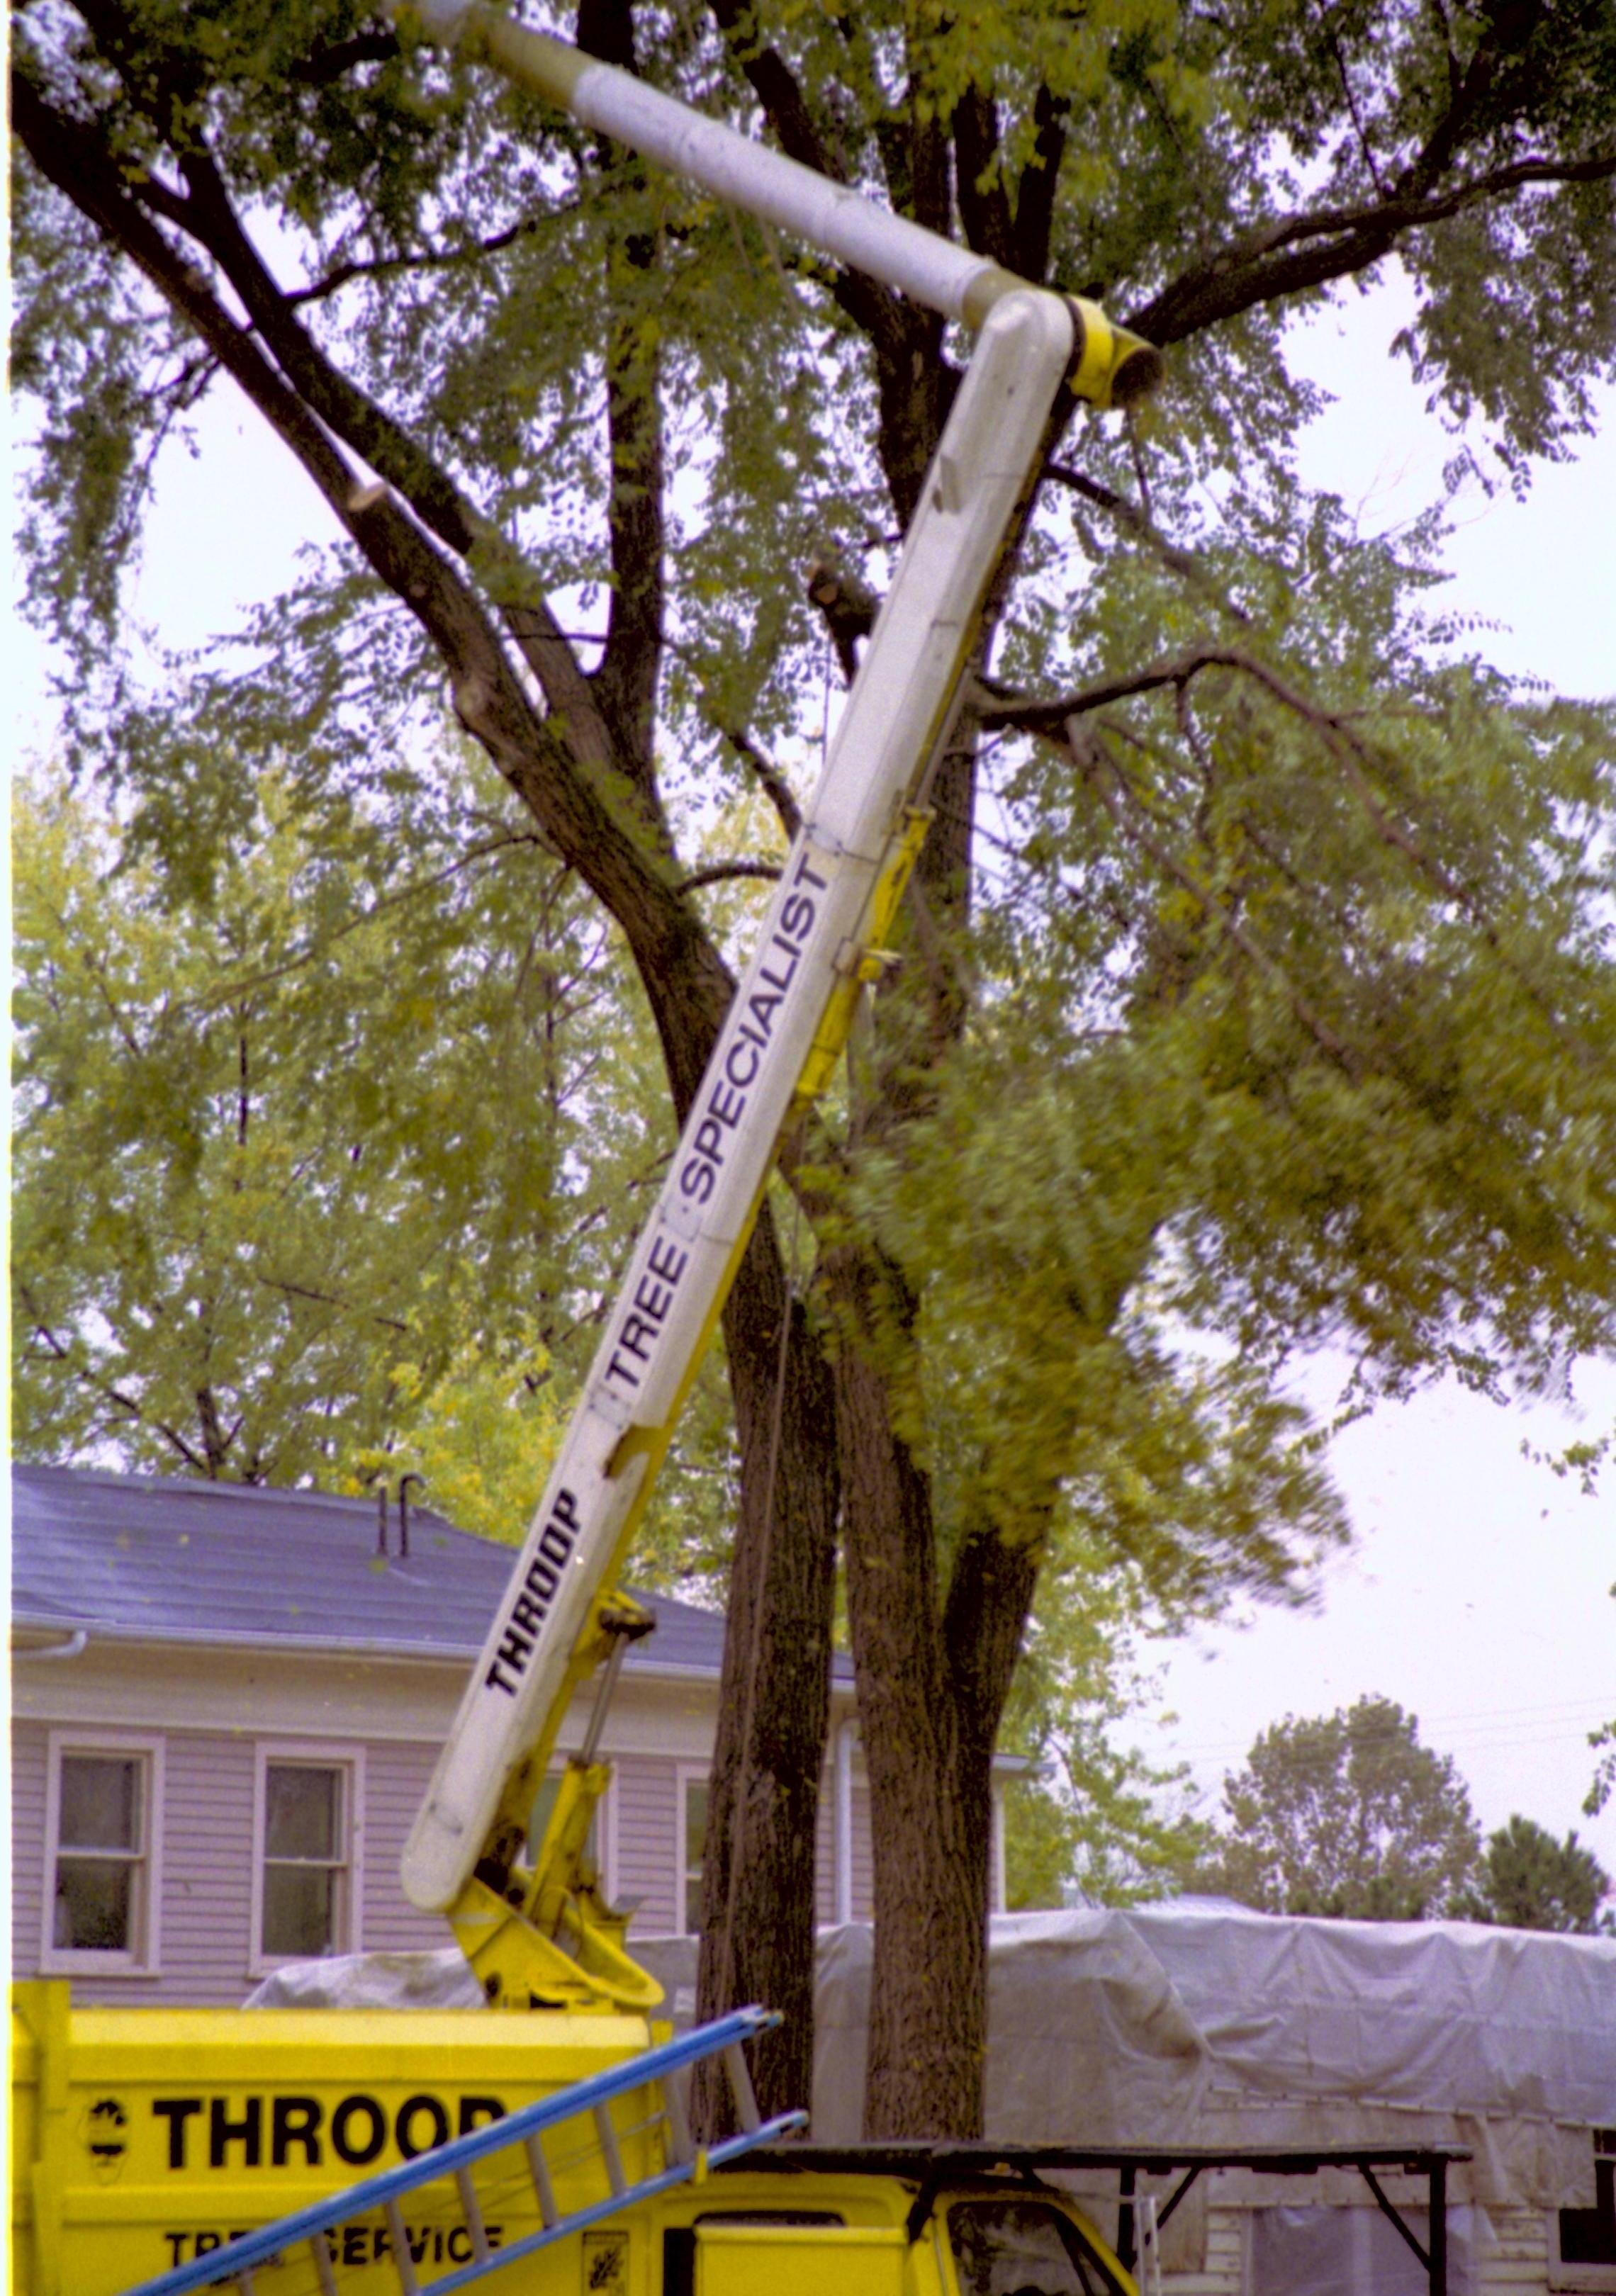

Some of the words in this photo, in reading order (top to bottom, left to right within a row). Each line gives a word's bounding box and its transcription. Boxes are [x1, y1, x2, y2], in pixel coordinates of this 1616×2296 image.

[605, 1236, 688, 1387] TREE
[680, 852, 827, 1204] SPECIALIST
[485, 1487, 581, 1697] THROOP
[165, 2231, 281, 2268] TR
